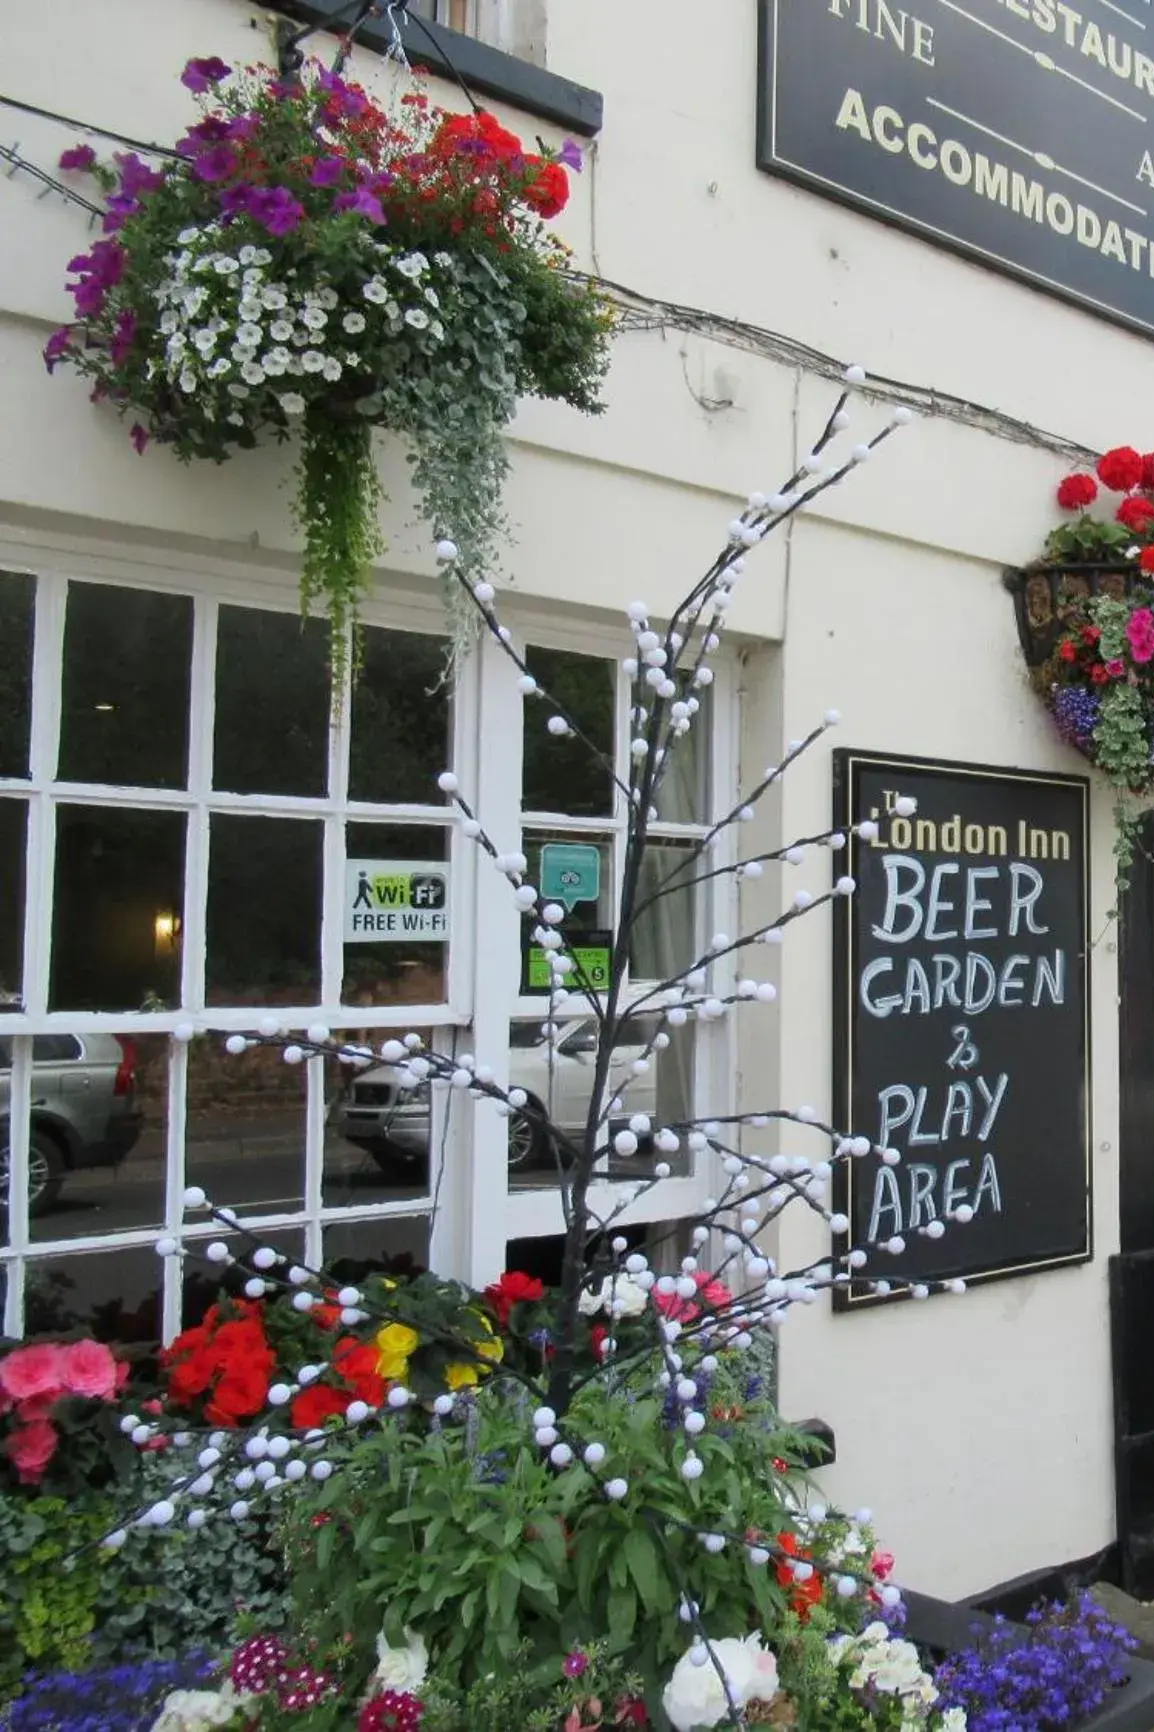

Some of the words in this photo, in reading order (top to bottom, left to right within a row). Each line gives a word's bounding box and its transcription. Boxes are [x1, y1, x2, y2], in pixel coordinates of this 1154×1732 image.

[870, 808, 1007, 856] London
[1019, 820, 1070, 860] Inn
[352, 914, 396, 931] FREE
[402, 913, 447, 931] Wi-Fi
[872, 854, 1049, 942] BEER
[860, 949, 1065, 1016] GARDEN
[879, 1073, 1008, 1150] PLAY
[868, 1153, 1001, 1242] AREA
